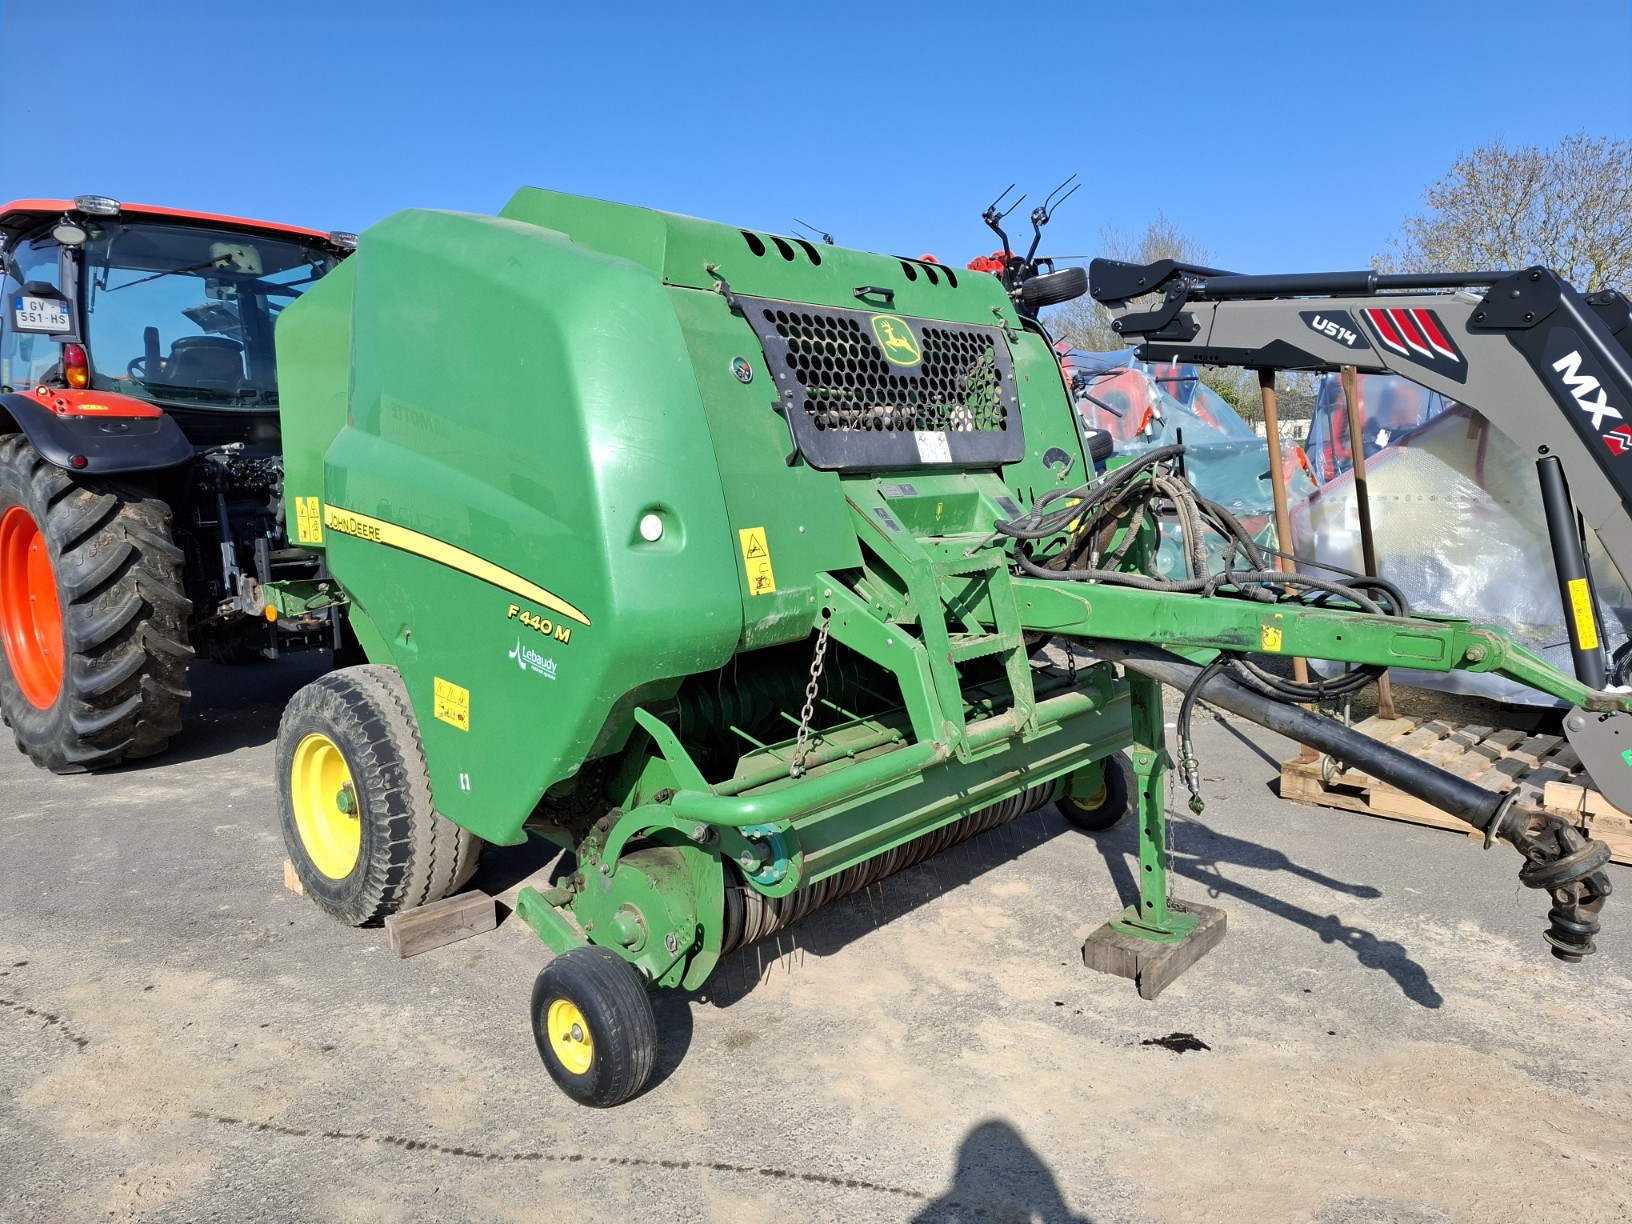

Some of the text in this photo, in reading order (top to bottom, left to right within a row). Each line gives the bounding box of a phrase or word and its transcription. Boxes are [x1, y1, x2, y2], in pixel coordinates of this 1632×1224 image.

[20, 312, 66, 324] 551-HS
[1312, 315, 1357, 346] U514
[1552, 350, 1623, 431] MX
[350, 517, 381, 541] DEERE
[507, 603, 572, 645] F 440 M
[522, 645, 558, 674] Lebaudy
